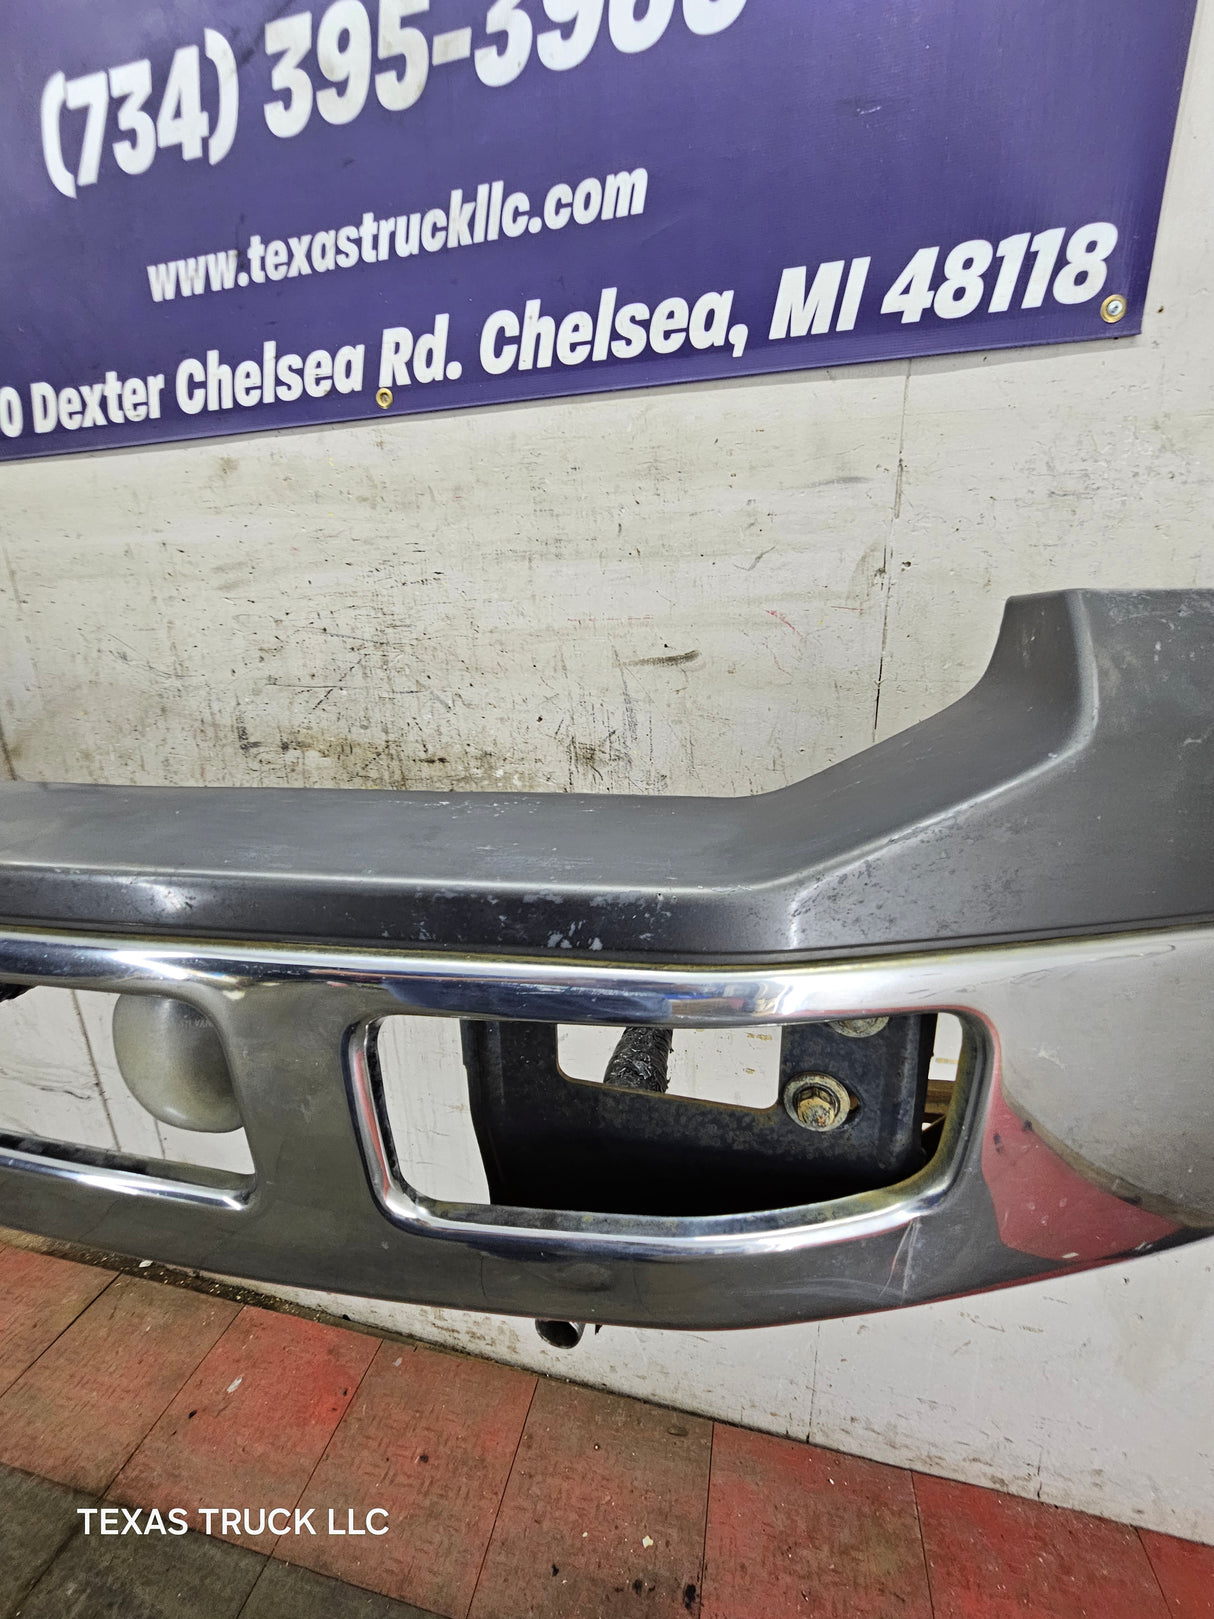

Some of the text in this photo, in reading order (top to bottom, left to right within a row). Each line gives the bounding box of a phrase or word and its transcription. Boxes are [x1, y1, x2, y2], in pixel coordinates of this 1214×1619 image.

[40, 0, 748, 199] (734) 395-39
[30, 371, 165, 434] Dexter
[176, 340, 365, 415] Chelsea
[378, 313, 463, 388] Rd.
[479, 286, 749, 375] Chelsea,
[768, 256, 871, 340] MI
[880, 221, 1119, 324] 48118
[146, 167, 648, 303] www.texastruckllc.com
